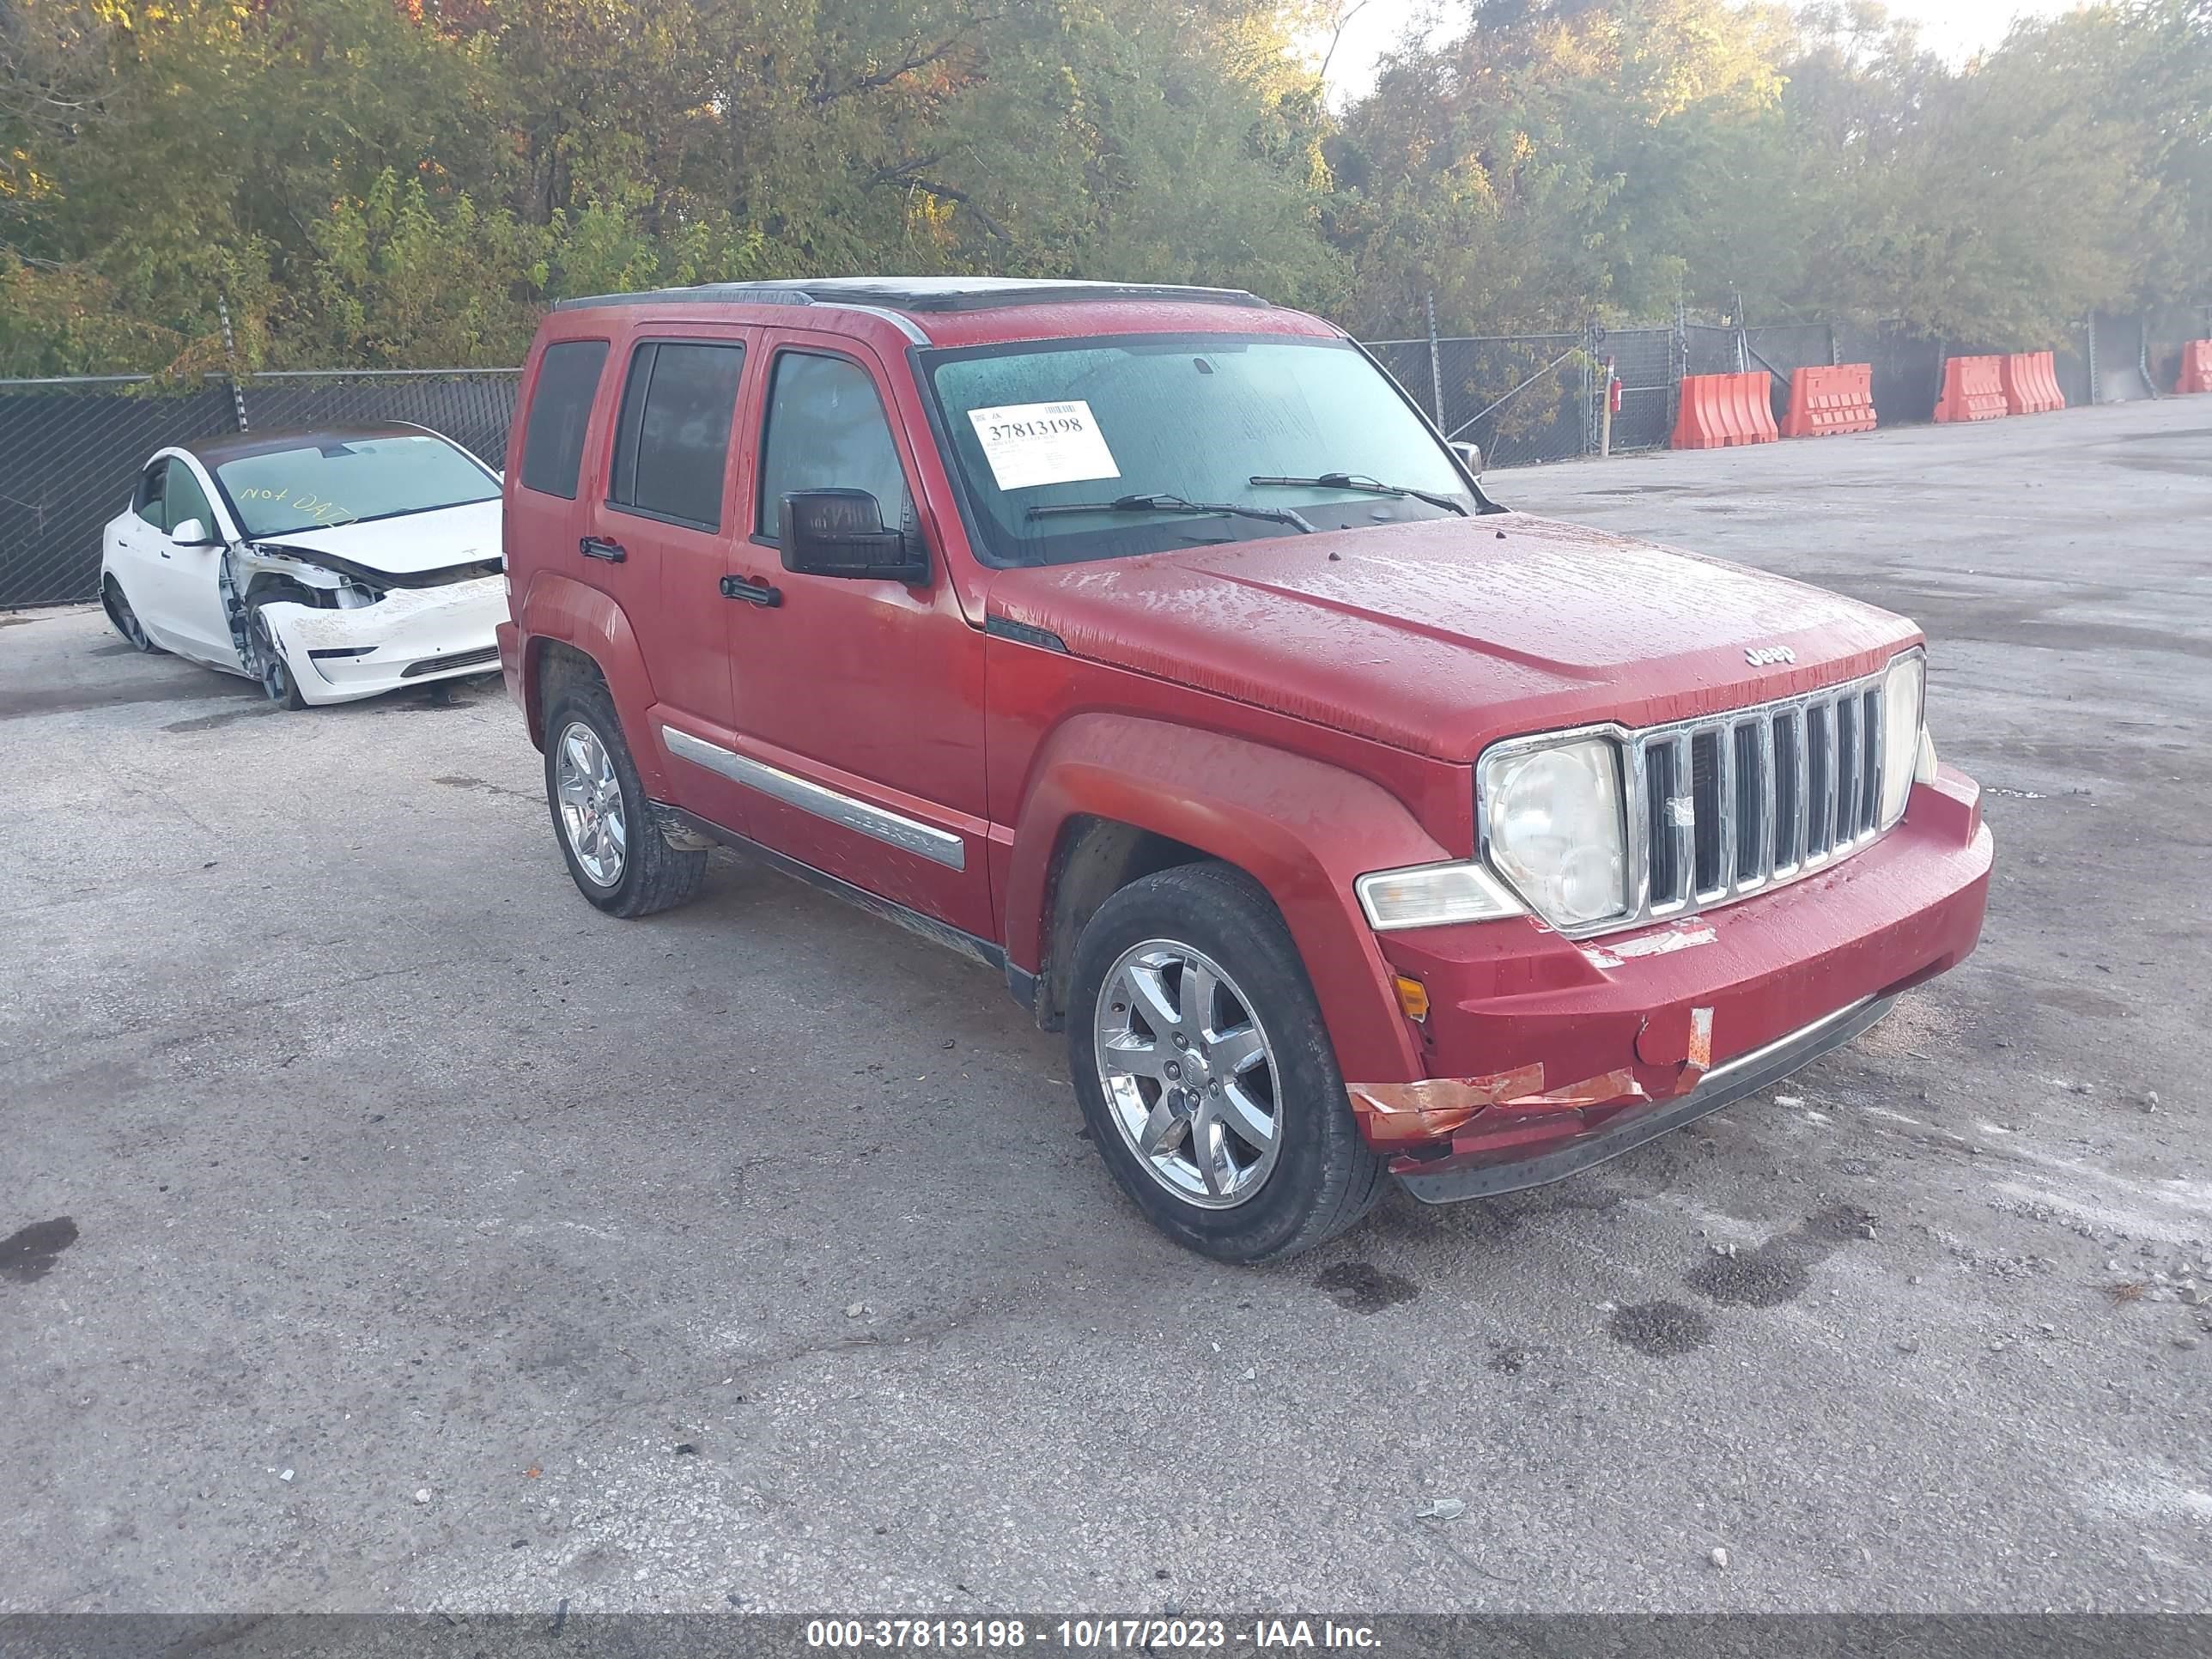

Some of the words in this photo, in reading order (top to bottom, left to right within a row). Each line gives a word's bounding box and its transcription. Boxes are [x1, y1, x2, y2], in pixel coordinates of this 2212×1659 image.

[988, 417, 1084, 441] 37813198
[1743, 645, 1796, 667] Jeep
[843, 808, 939, 852] LIBERTY
